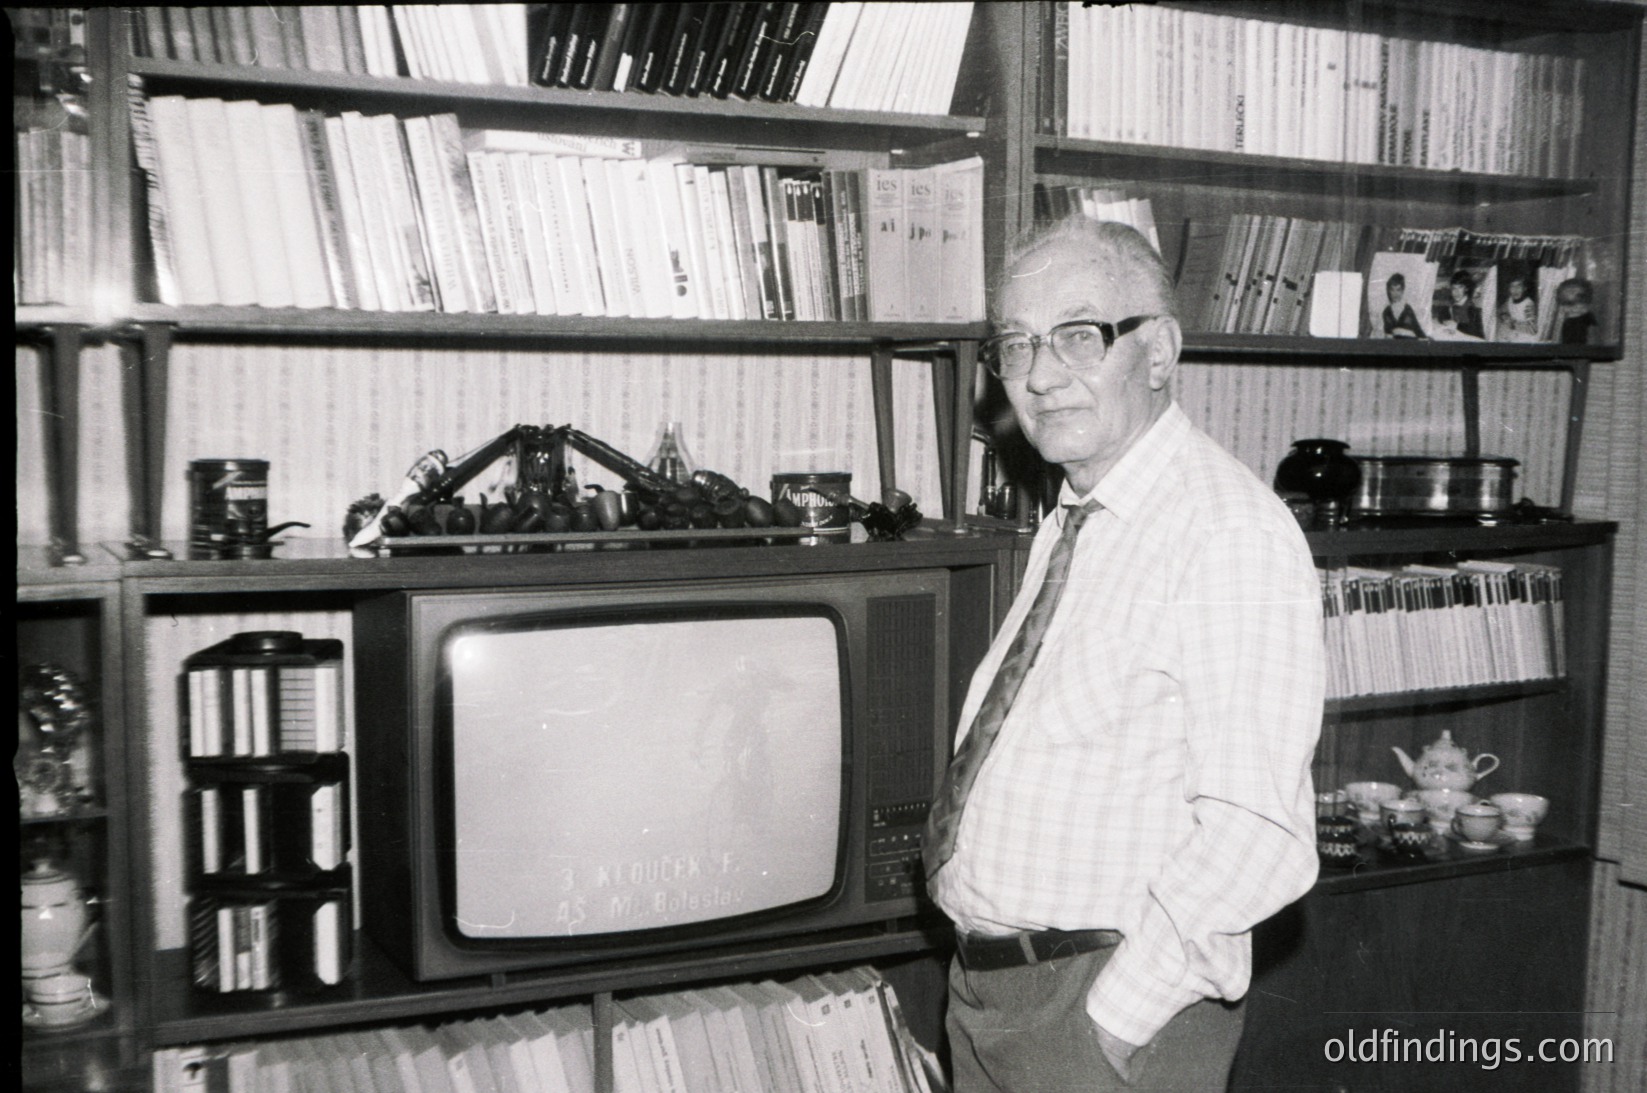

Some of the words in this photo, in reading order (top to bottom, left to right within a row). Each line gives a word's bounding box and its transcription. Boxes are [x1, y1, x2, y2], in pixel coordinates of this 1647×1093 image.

[1235, 94, 1245, 149] TERLECKI
[876, 173, 898, 192] ies
[911, 179, 932, 196] ies
[625, 247, 641, 296] WILSON
